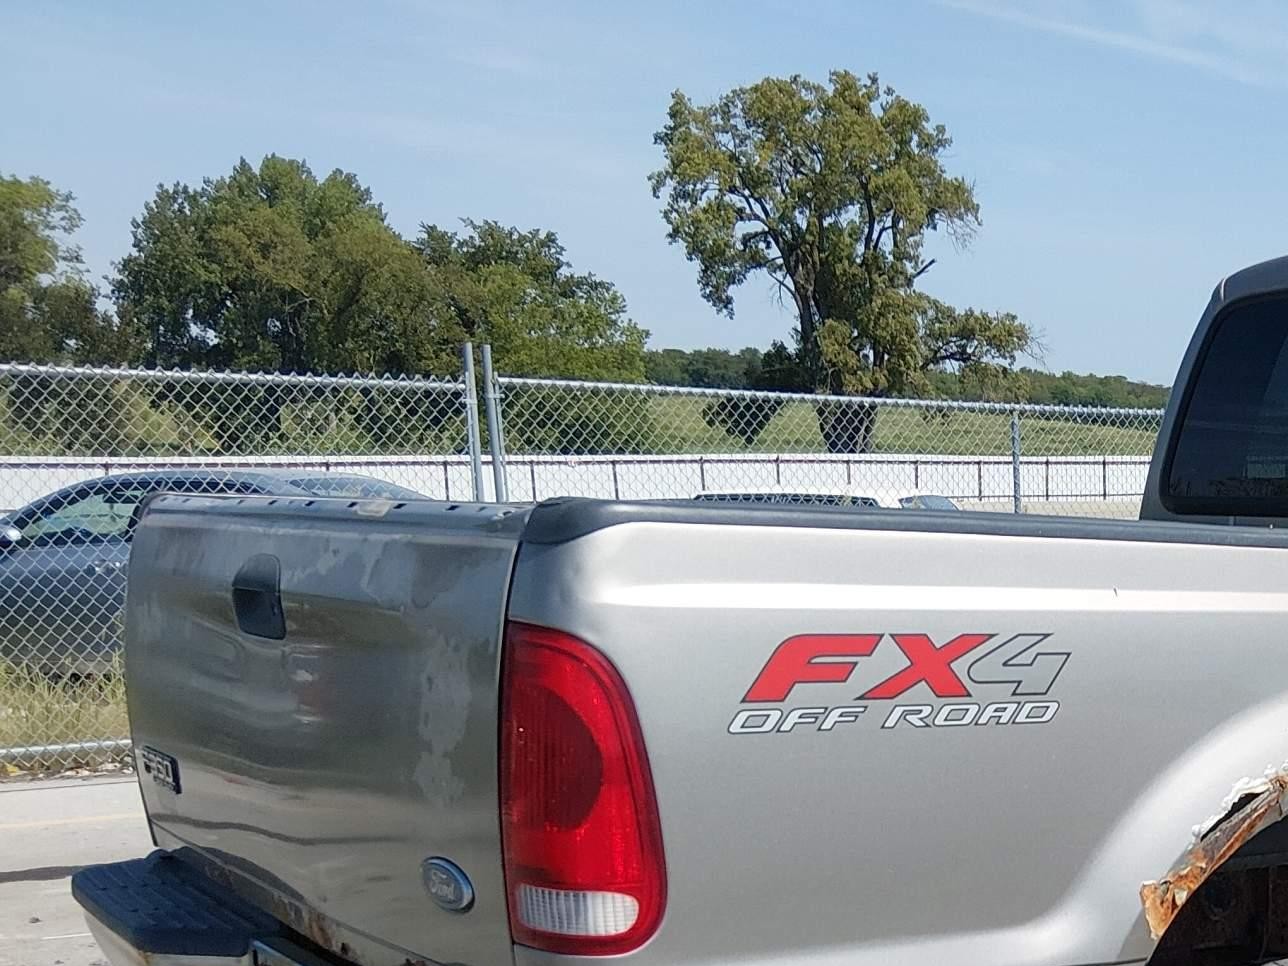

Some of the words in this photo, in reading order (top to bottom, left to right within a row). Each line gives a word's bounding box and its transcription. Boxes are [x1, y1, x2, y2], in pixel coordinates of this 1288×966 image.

[740, 632, 1073, 703] FX4
[727, 705, 869, 735] OFF
[880, 700, 1062, 730] ROAD
